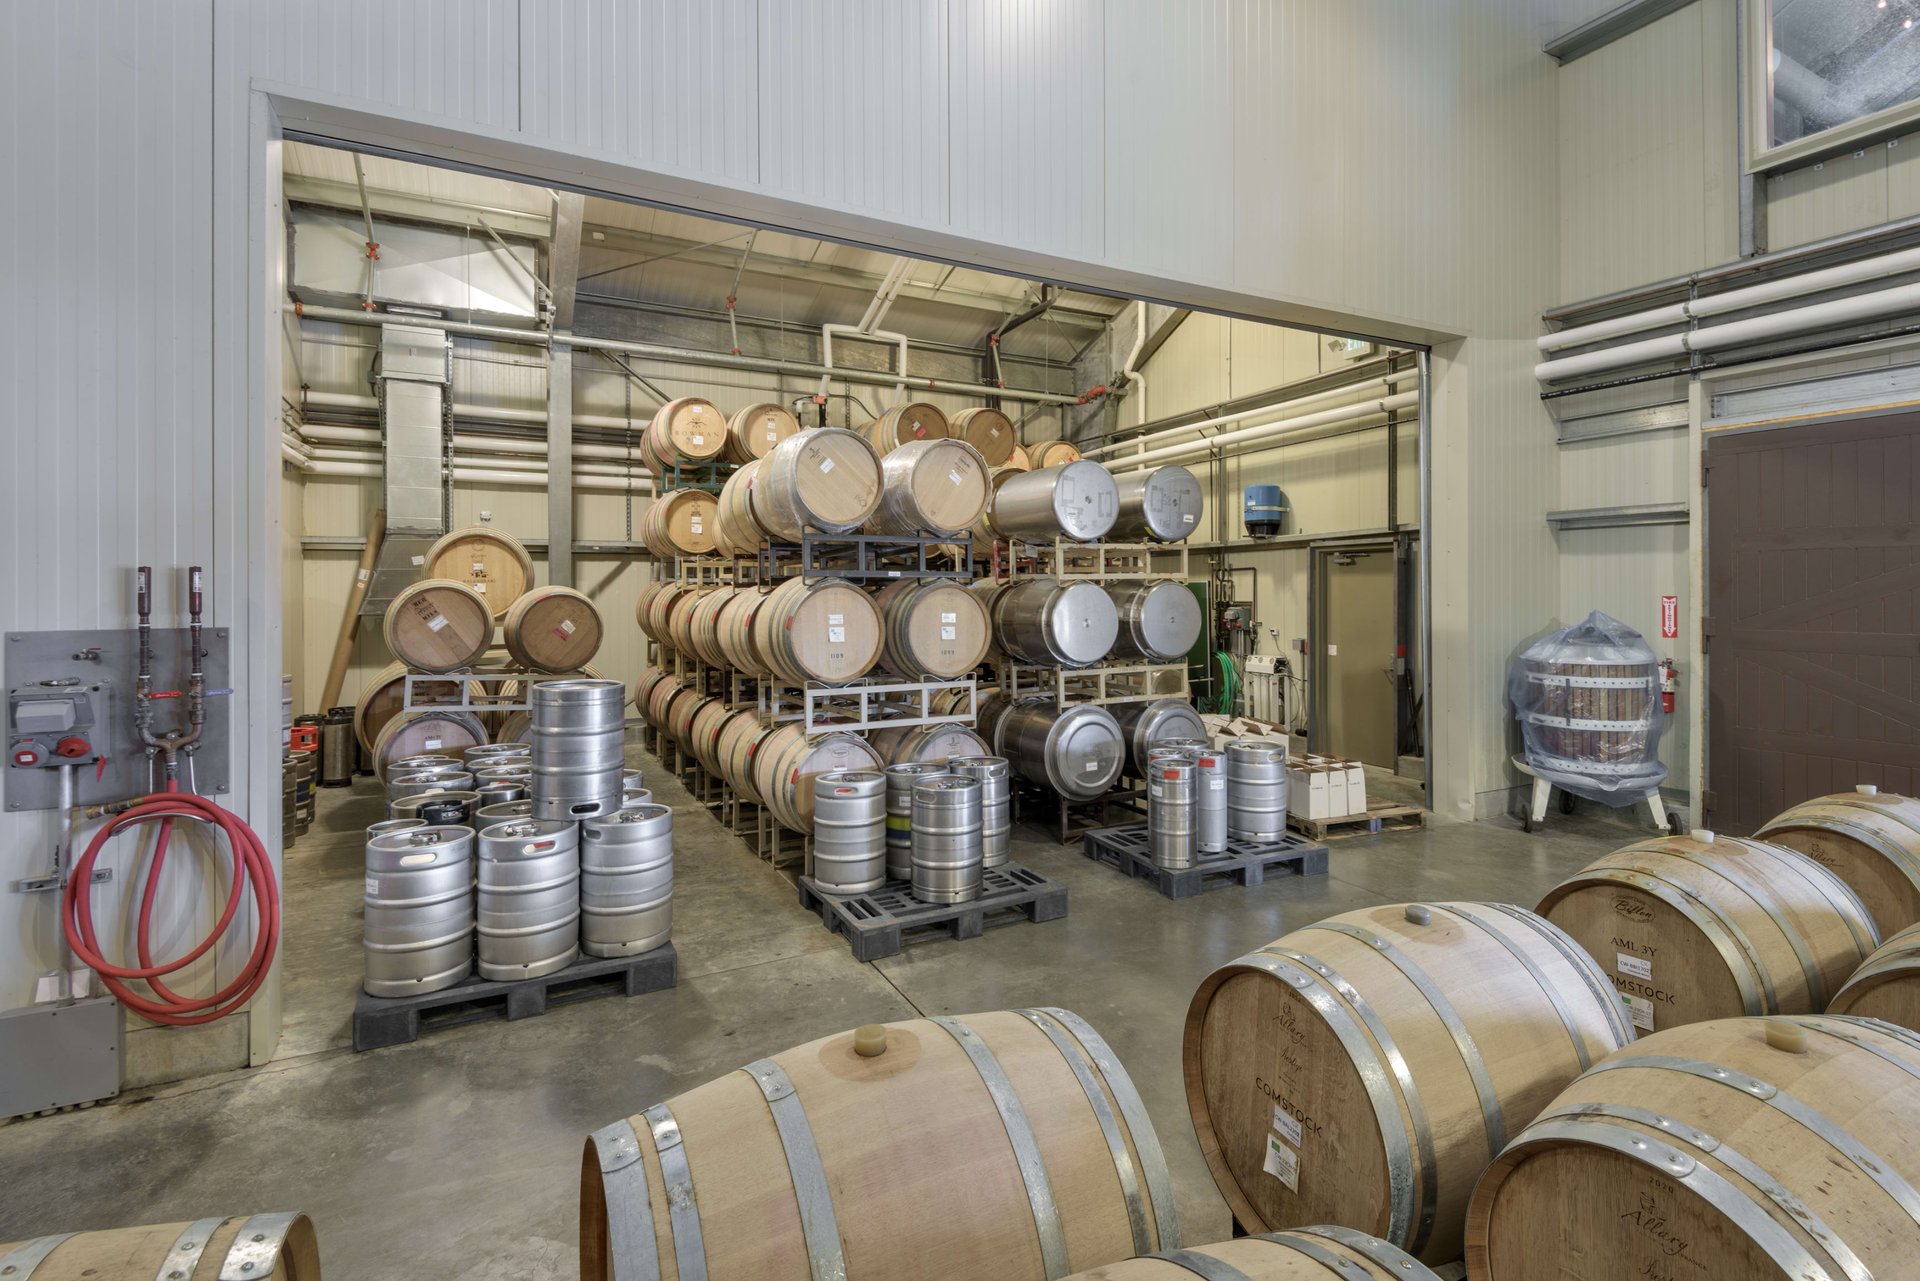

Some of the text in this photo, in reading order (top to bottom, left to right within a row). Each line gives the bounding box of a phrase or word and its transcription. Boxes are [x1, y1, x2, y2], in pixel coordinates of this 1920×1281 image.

[1611, 936, 1657, 957] AML 3Y
[1272, 1014, 1305, 1045] Allary
[1255, 1077, 1322, 1138] COMSTOCK
[1649, 1177, 1674, 1194] 2020
[1620, 1210, 1689, 1256] Allary
